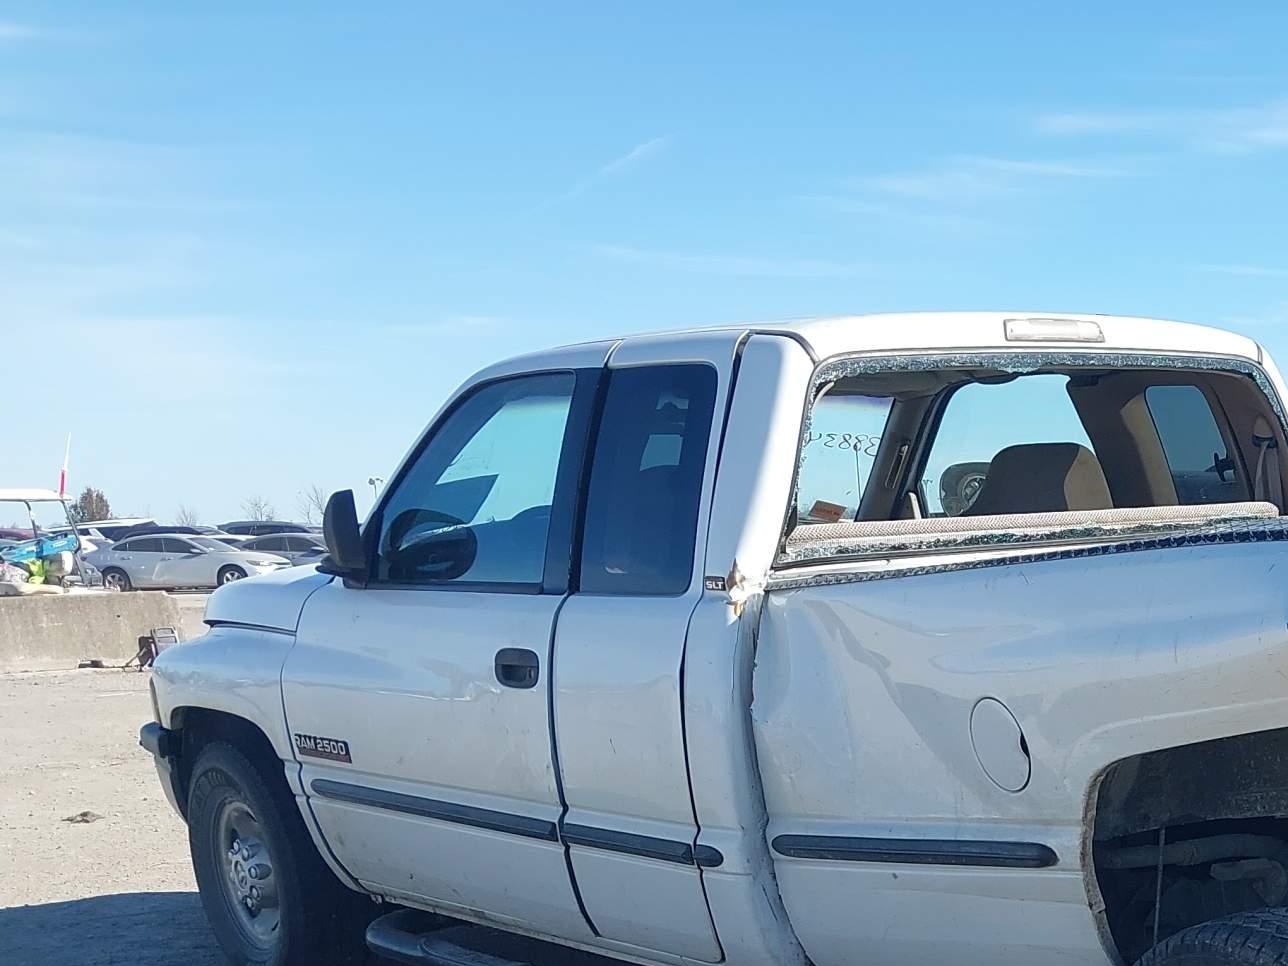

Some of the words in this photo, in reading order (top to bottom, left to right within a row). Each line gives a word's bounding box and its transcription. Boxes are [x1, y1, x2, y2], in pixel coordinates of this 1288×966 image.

[706, 577, 724, 589] SLT
[294, 735, 315, 750] RAM
[316, 738, 346, 755] 2500
